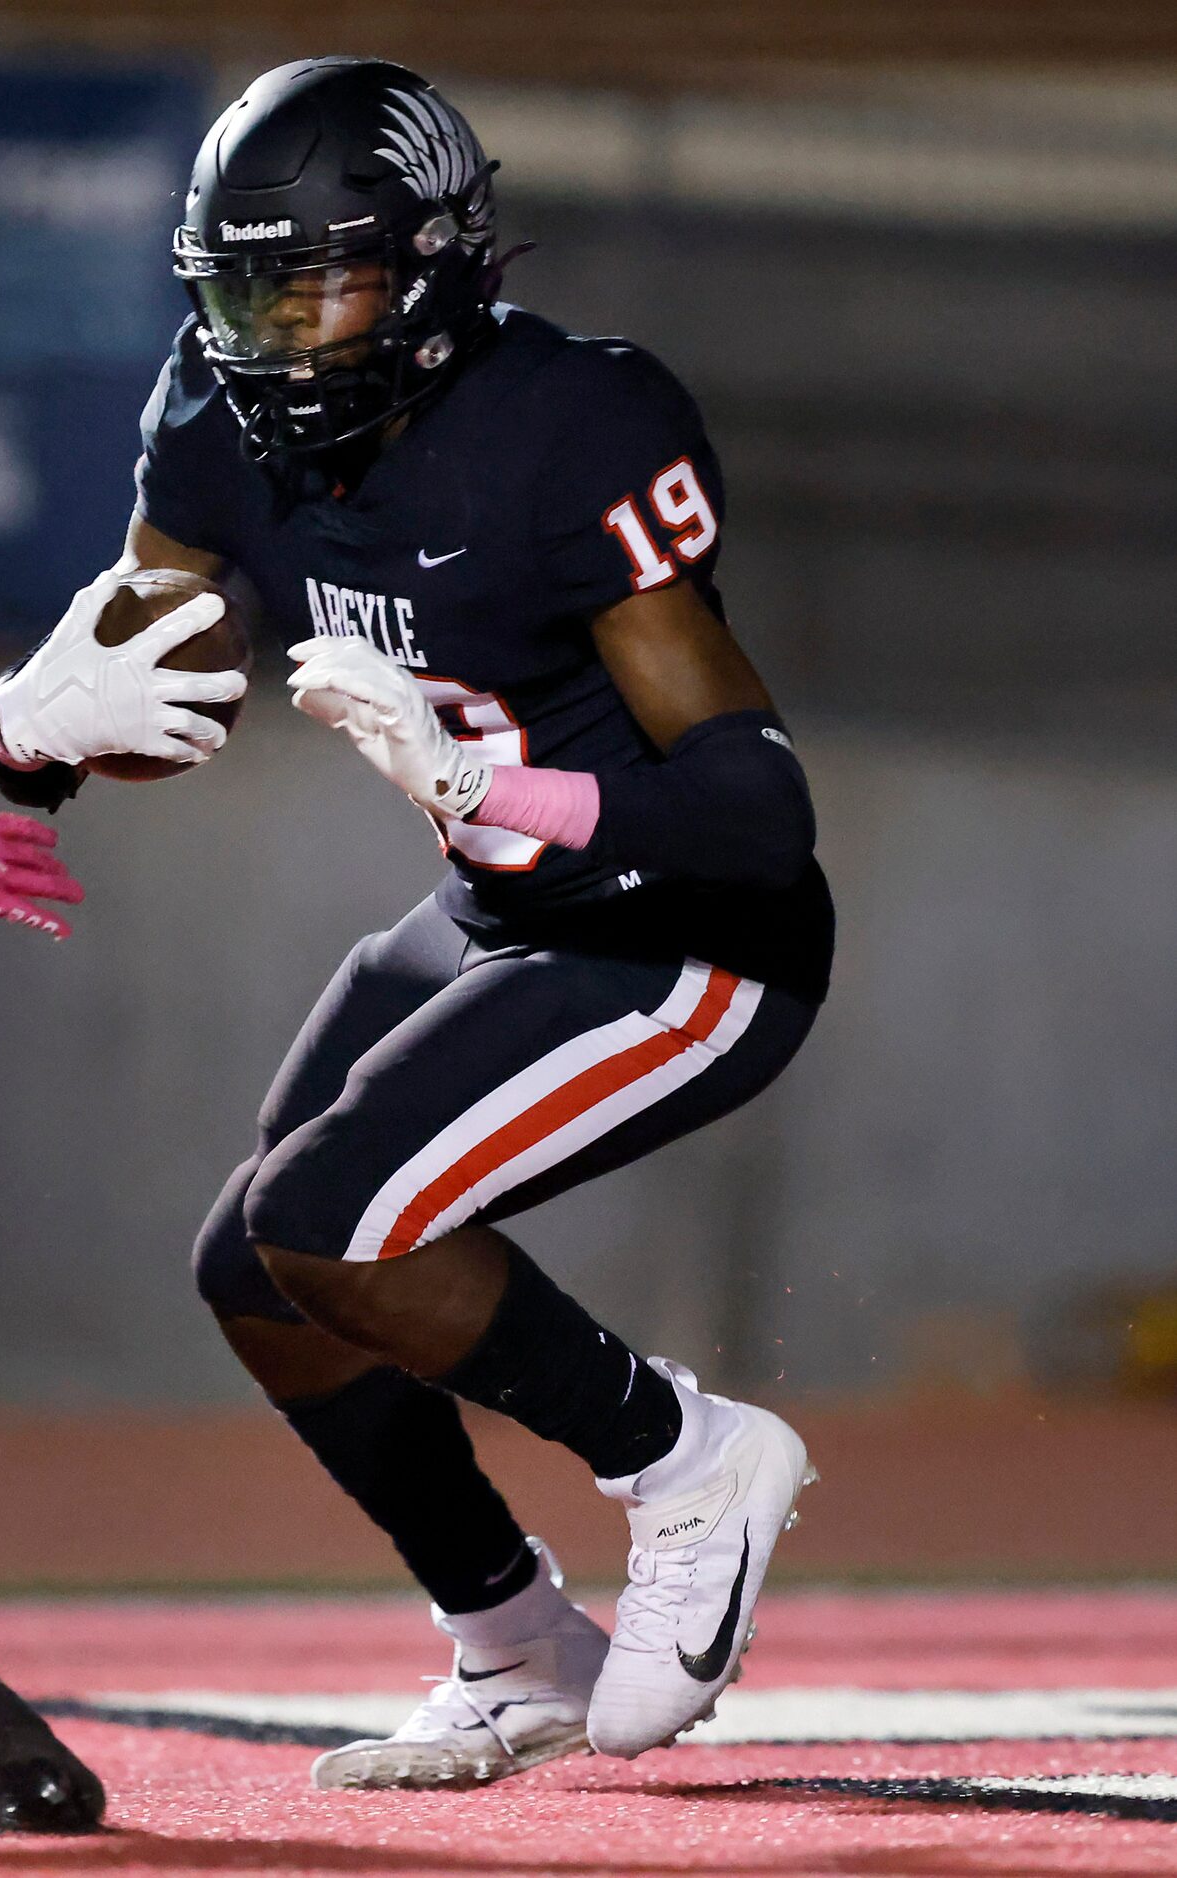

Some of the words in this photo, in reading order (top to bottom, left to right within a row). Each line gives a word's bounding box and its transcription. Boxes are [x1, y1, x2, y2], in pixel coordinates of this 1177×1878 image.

[219, 219, 291, 241] Riddell
[601, 454, 718, 595] 19
[305, 577, 428, 668] ARGYLE
[617, 869, 643, 892] M
[656, 1516, 706, 1539] ALPHA
